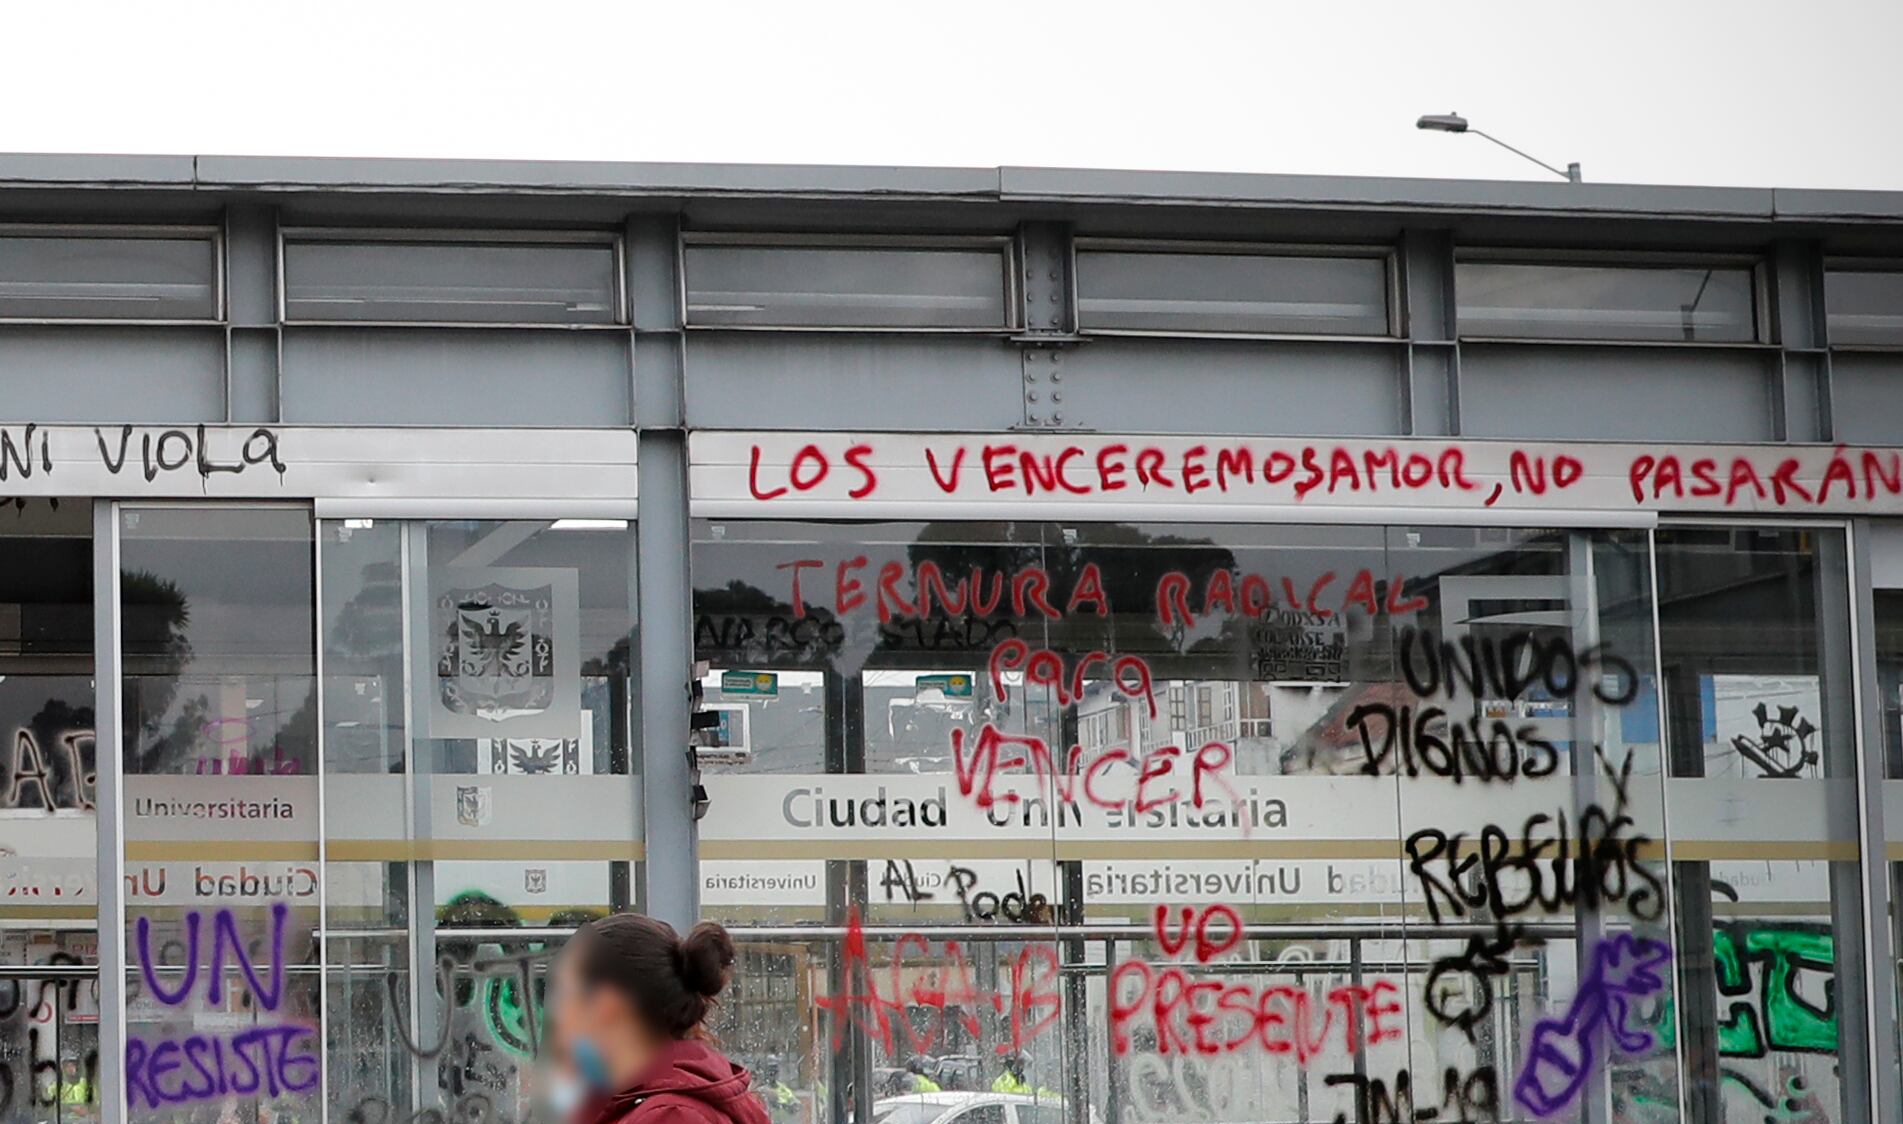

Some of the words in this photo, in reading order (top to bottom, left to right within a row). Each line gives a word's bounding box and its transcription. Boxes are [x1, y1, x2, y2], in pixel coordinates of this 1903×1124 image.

[750, 443, 878, 500] LOS
[925, 444, 1324, 499] VENCEREMOS
[1510, 449, 1584, 495] NO
[776, 556, 1108, 623] TERNURA
[1156, 569, 1428, 627] RADICAL
[1399, 630, 1639, 706] UNIDOS
[951, 724, 1252, 838] VENCER
[1346, 704, 1560, 785] DIGNOS
[135, 796, 294, 820] Universitaria
[782, 786, 948, 828] Ciudad
[137, 902, 288, 1011] UN
[1110, 959, 1402, 1065] PRESENTE
[126, 1024, 319, 1109] RESISTE
